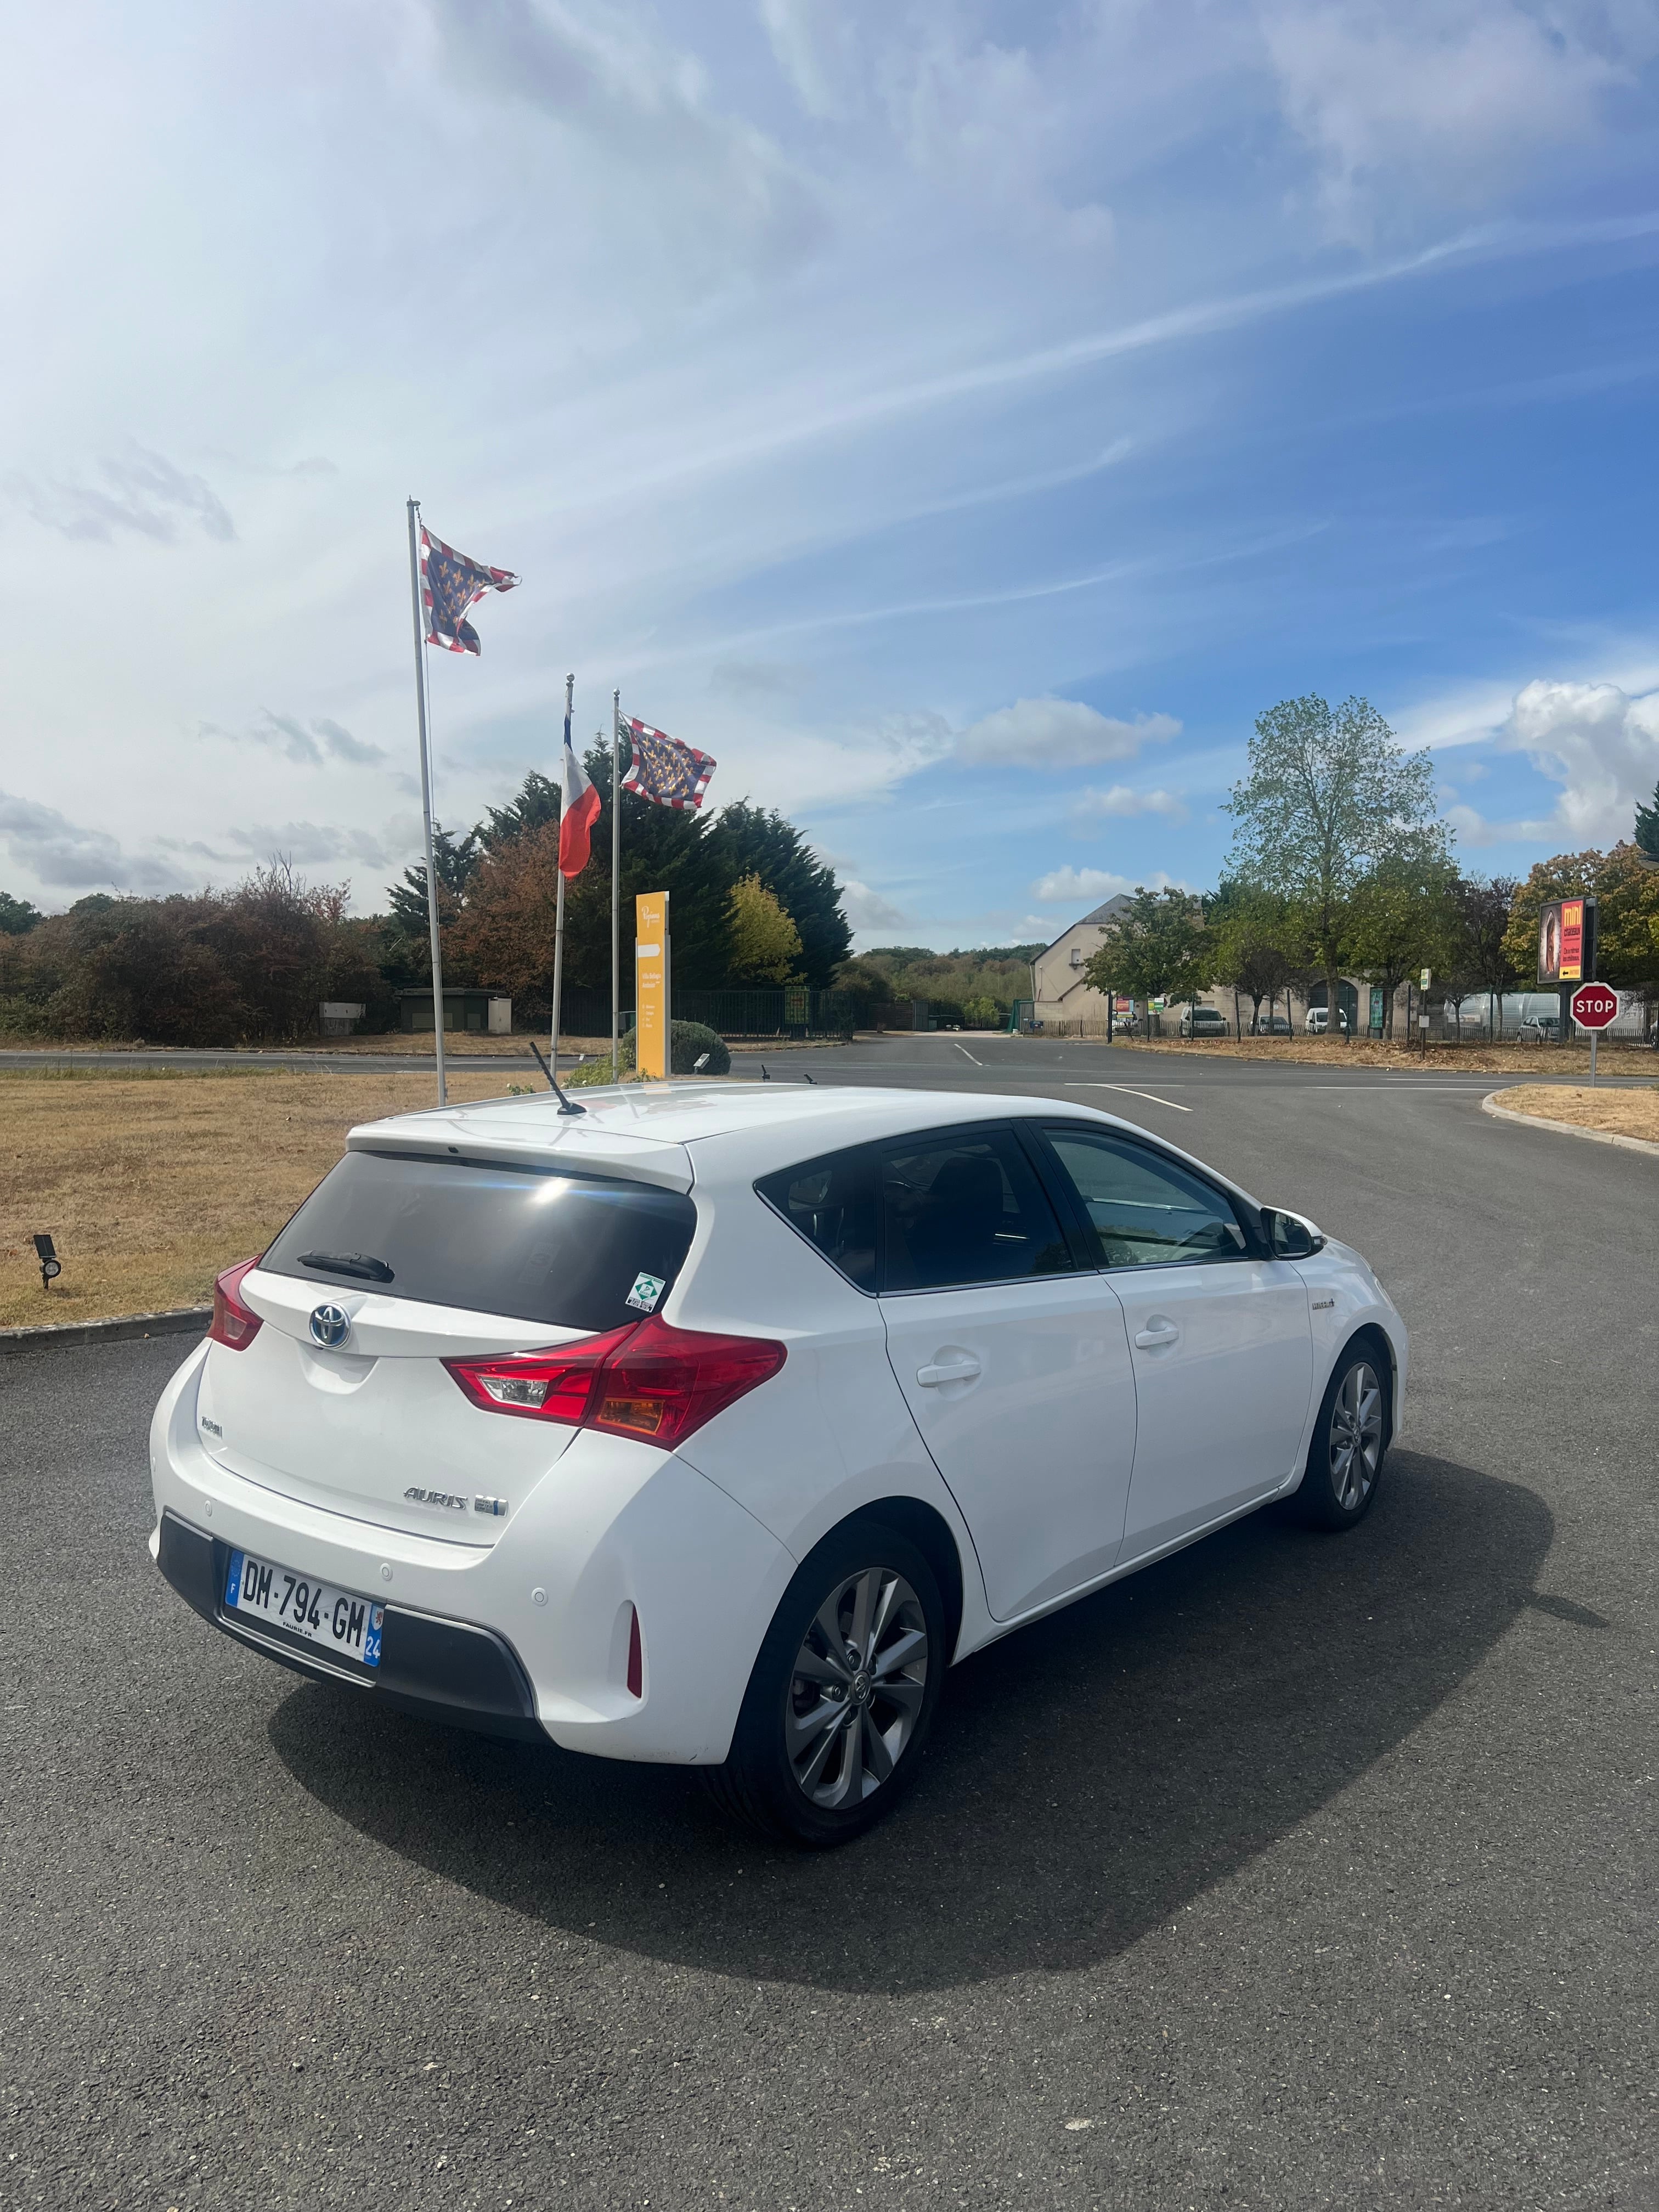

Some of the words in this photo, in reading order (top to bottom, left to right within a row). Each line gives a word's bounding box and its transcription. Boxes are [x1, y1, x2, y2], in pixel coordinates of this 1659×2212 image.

[1564, 905, 1581, 927] mini
[1576, 1000, 1614, 1013] STOP
[403, 1486, 468, 1510] AURIS
[230, 1583, 236, 1594] F
[282, 1621, 313, 1638] FAURIE.FR
[365, 1635, 381, 1659] 24
